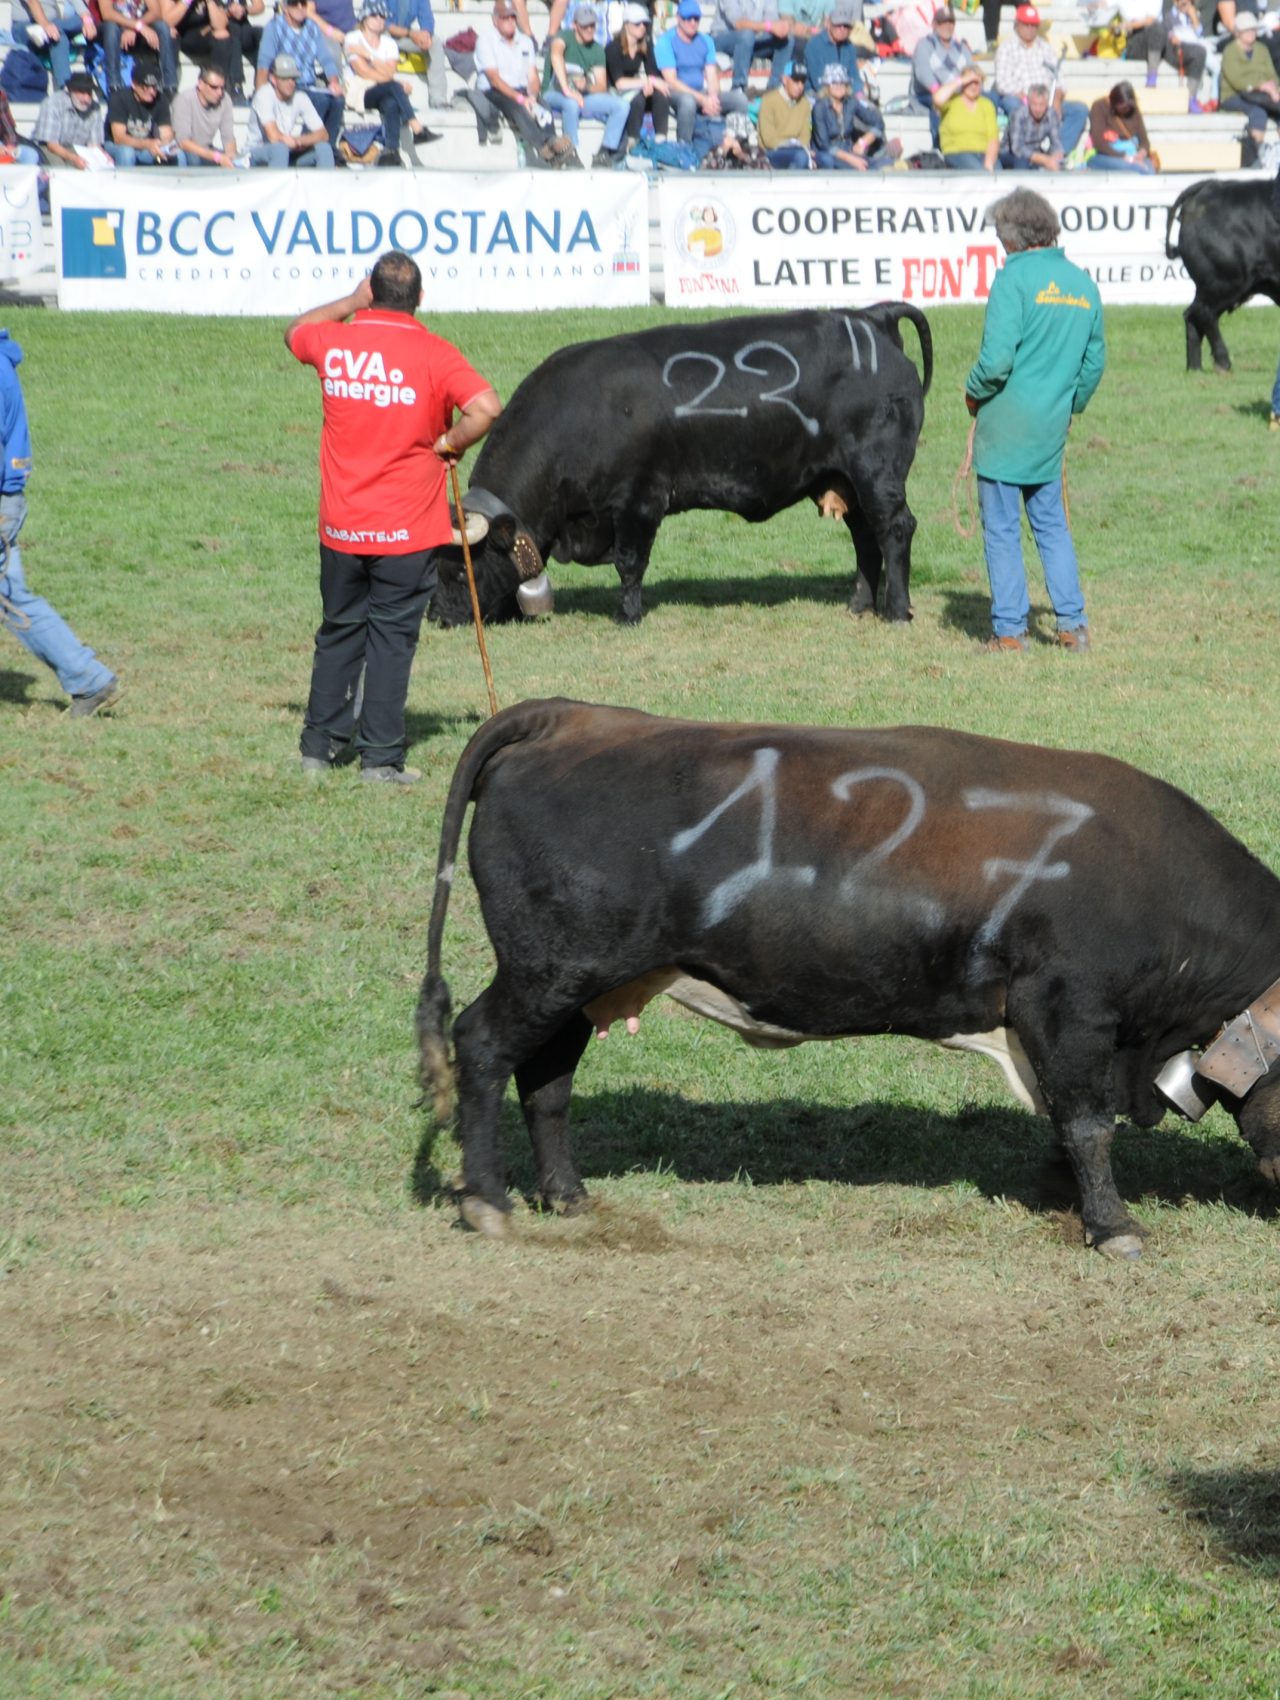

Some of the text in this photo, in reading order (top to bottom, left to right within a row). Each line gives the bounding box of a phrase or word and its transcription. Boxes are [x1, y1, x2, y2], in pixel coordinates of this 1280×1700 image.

[136, 209, 602, 256] BCC VALDOSTANA
[139, 267, 251, 281] CREDITO
[478, 264, 606, 280] ITALIANO
[679, 273, 740, 294] FONTINA
[753, 258, 861, 286] LATTE
[874, 257, 893, 285] E
[902, 245, 1004, 299] FONT
[324, 348, 387, 381] CVA
[324, 378, 416, 407] energie
[324, 525, 410, 543] RABATTEUR
[669, 746, 1096, 955] 127
